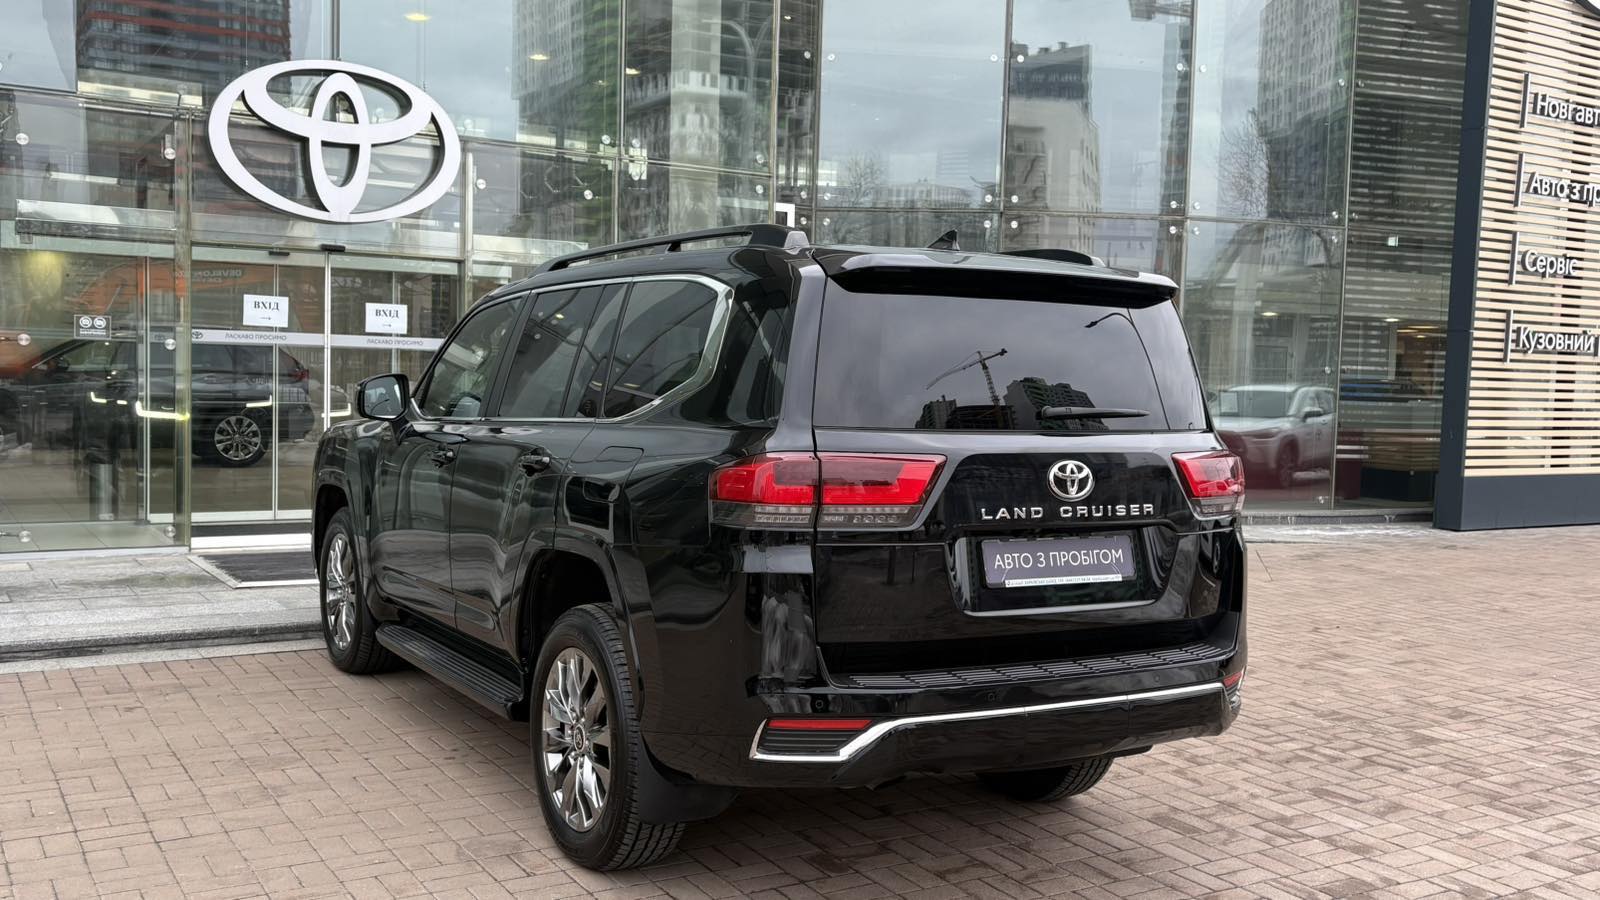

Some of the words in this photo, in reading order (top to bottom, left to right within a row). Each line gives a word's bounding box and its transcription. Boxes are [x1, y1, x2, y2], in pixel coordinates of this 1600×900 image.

[1529, 171, 1568, 198] Авто
[1570, 182, 1580, 200] з
[1524, 249, 1579, 279] Сервіс
[253, 300, 280, 311] ВХІД
[375, 308, 400, 319] ВХІД
[1519, 325, 1595, 354] Кузовний
[981, 507, 1044, 520] LAND
[1060, 503, 1155, 518] CRUISER
[994, 552, 1033, 570] АВТО
[1037, 552, 1047, 568] З
[1049, 548, 1124, 567] ПРОБІГОМ
